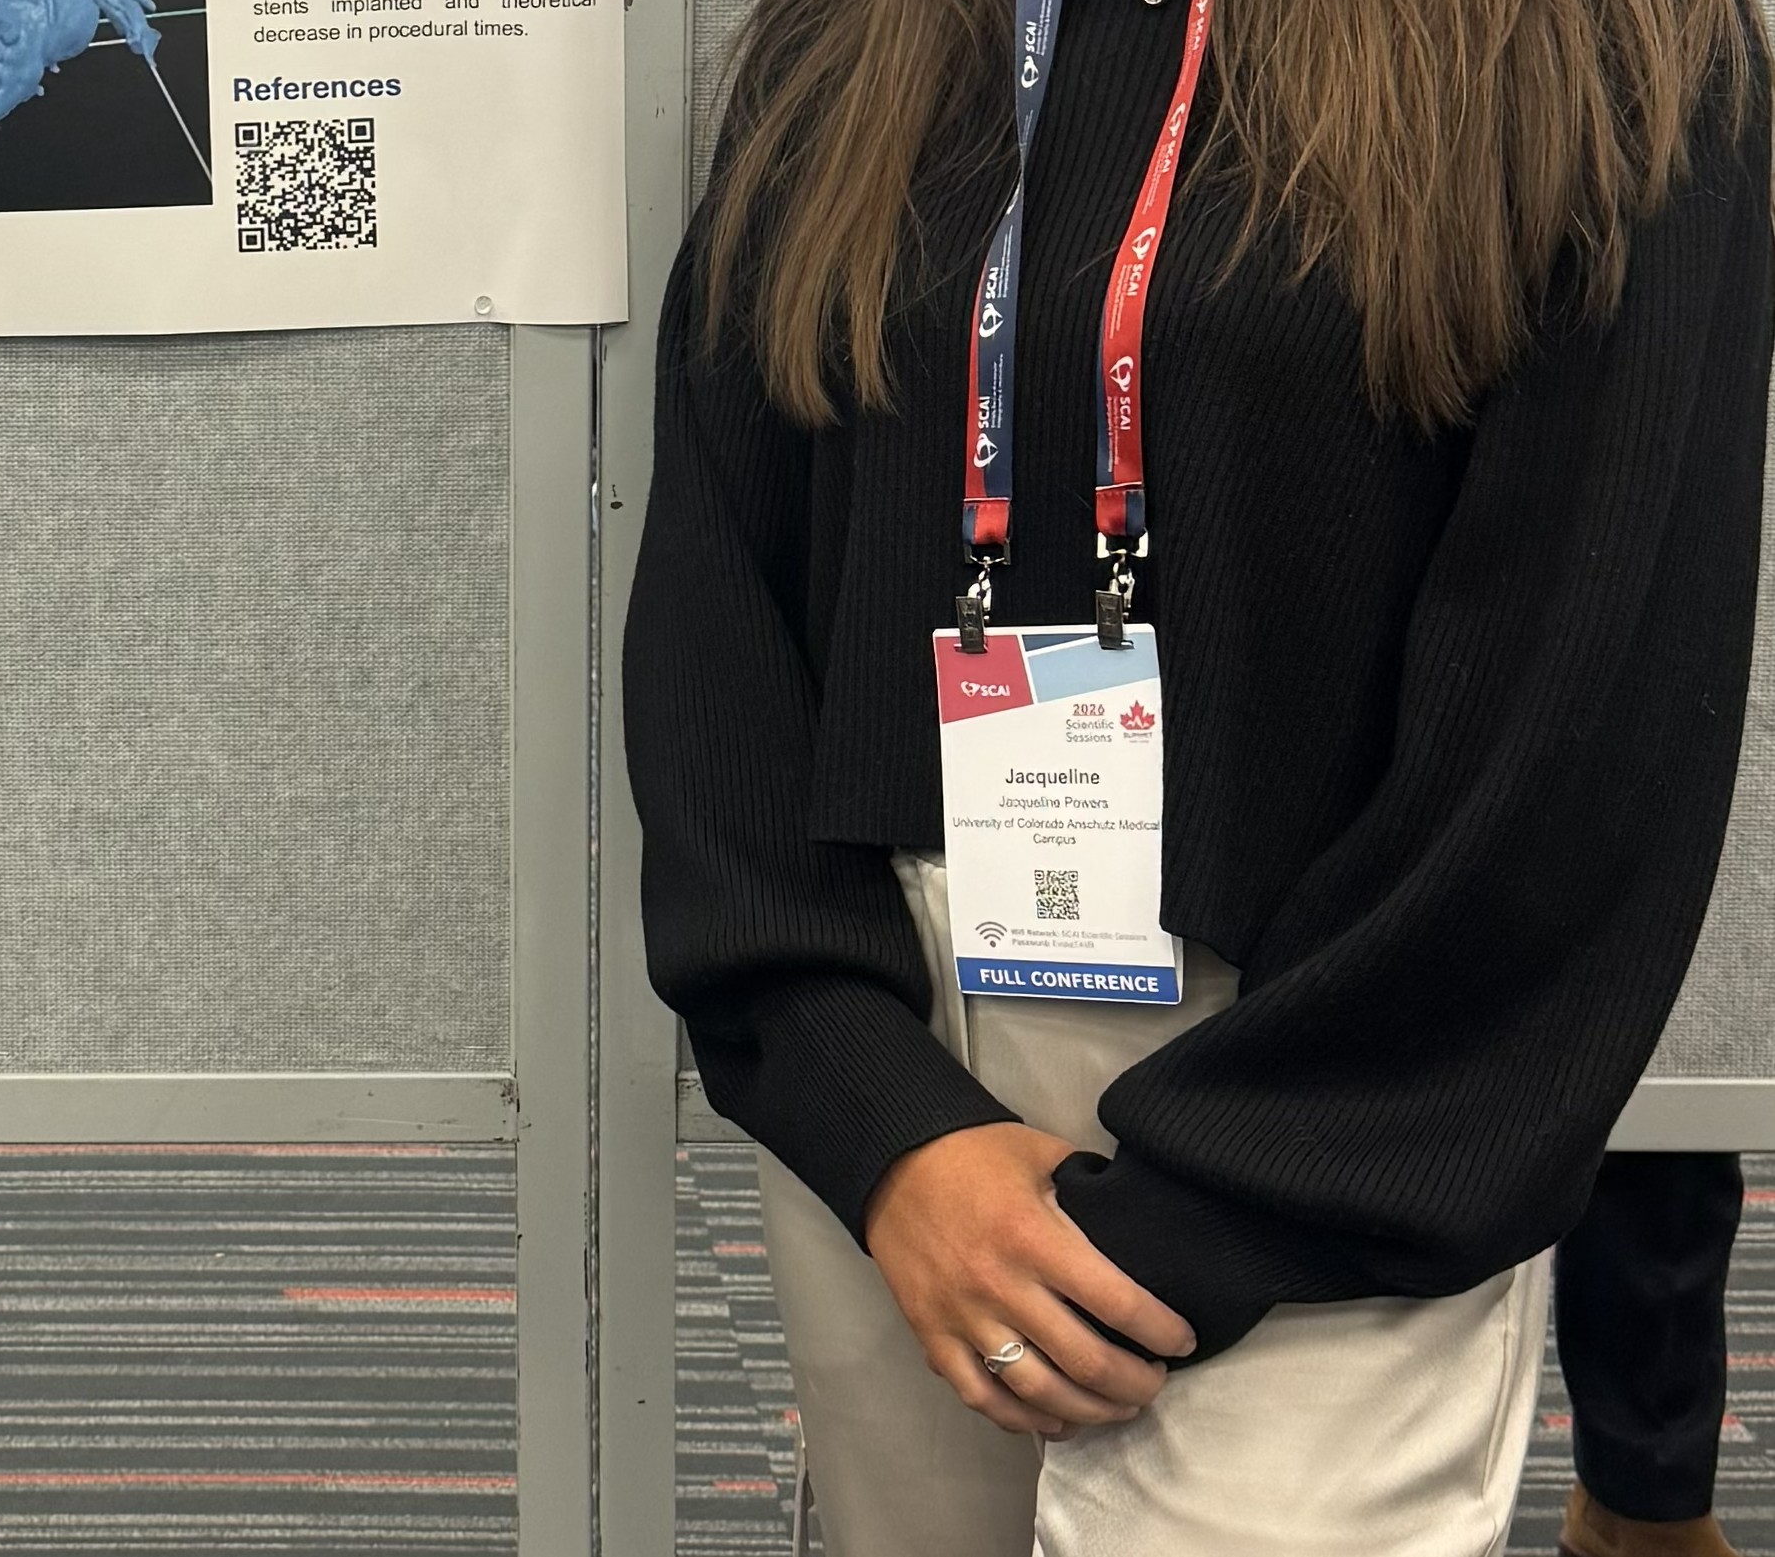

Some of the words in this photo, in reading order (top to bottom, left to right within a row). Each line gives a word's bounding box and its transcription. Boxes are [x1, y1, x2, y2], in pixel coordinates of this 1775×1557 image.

[1025, 21, 1037, 53] SCAI
[233, 76, 402, 102] References
[985, 266, 999, 299] SCAI
[1127, 263, 1144, 296] SCAI
[978, 396, 991, 429] SCAI
[1119, 396, 1131, 430] SCAI
[980, 684, 1011, 697] SCAI
[1072, 703, 1105, 716] 2026
[1065, 718, 1115, 731] Scientific
[1065, 731, 1113, 743] Sessions
[1005, 768, 1100, 789] Jacqueline
[979, 968, 1027, 986] FULL
[1030, 970, 1160, 993] CONFERENCE
